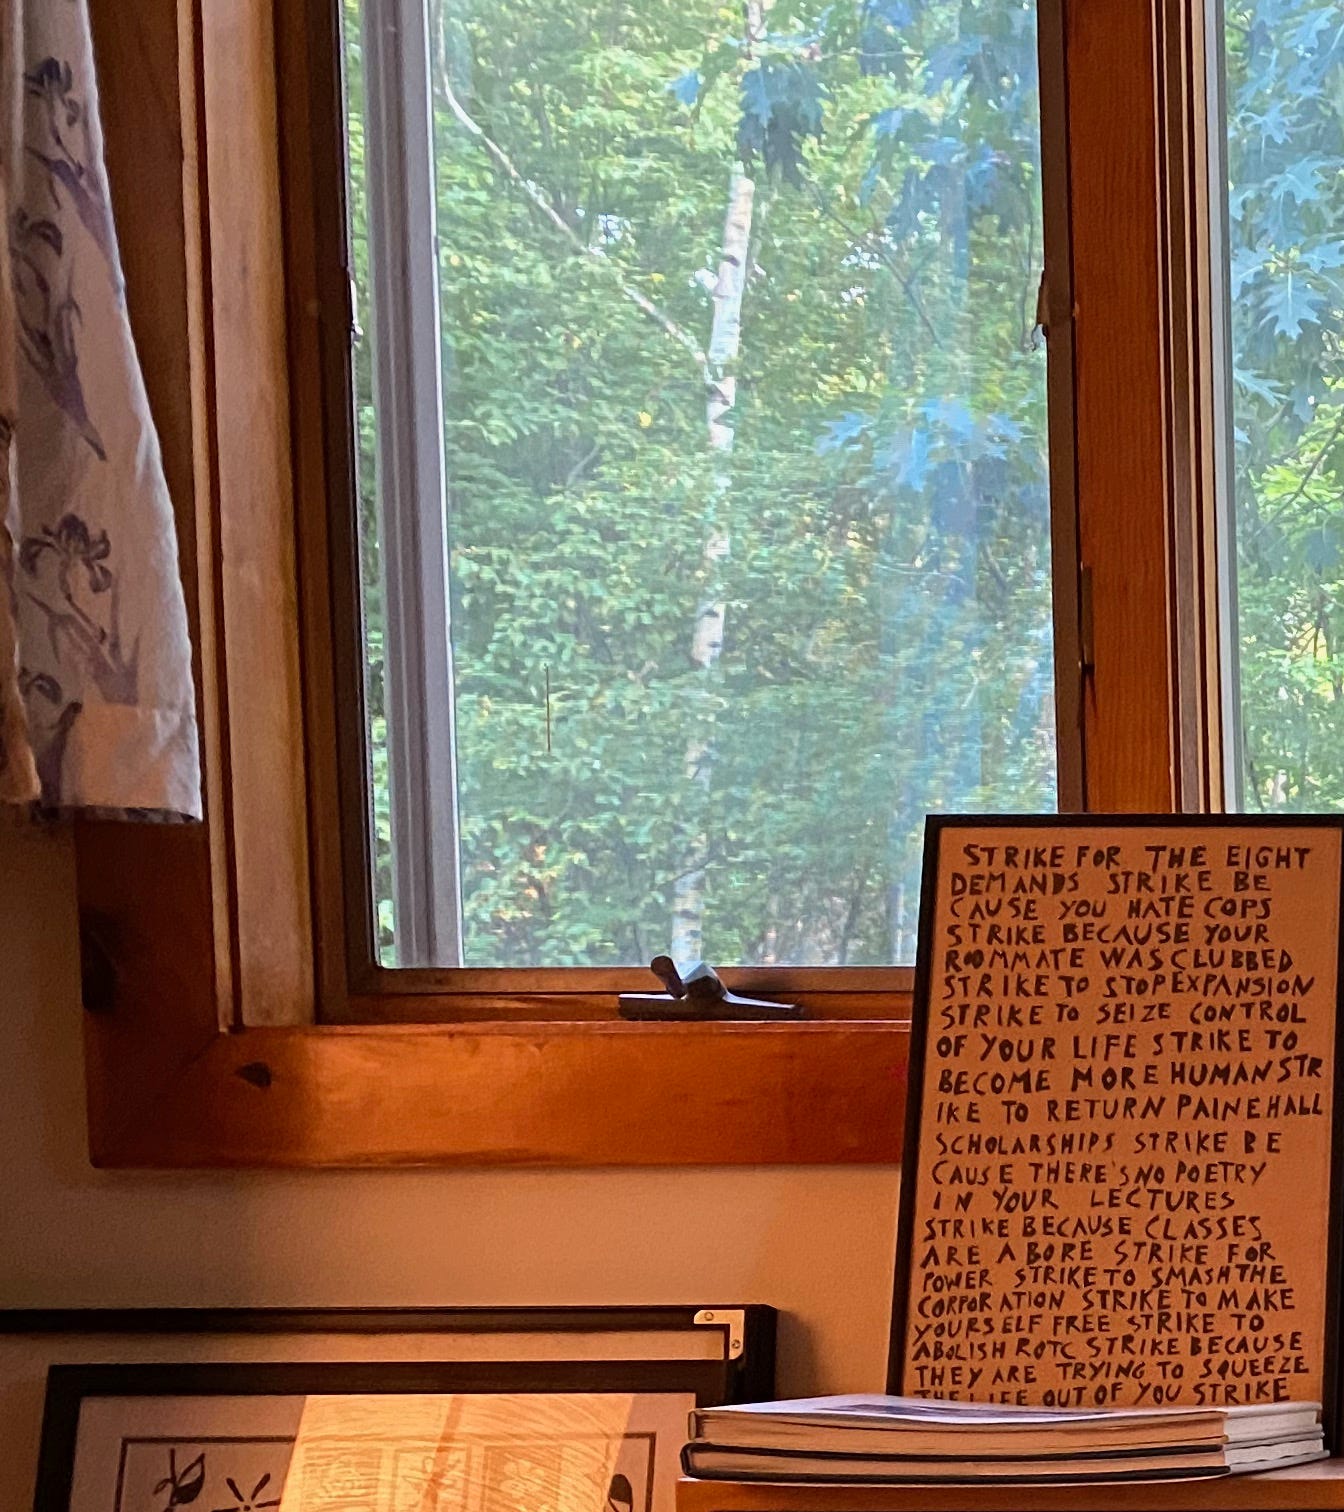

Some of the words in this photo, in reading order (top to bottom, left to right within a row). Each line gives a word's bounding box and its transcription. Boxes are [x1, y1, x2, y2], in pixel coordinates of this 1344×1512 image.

[964, 844, 1065, 869] STRIKE
[1076, 846, 1121, 869] FOR
[1145, 846, 1208, 869] THE
[1226, 846, 1311, 870] EIGHT
[950, 898, 1037, 920] CAUSE
[1060, 900, 1106, 919] YOU
[1128, 898, 1194, 918] HATE
[1204, 899, 1272, 919] COPS
[946, 924, 1045, 946] STRIKE
[1062, 924, 1190, 944] BECAUSE
[1204, 924, 1269, 944] YOUR
[940, 1004, 1043, 1030] STRIKE
[1056, 1004, 1079, 1024] TO
[1096, 1002, 1171, 1024] SEIZE
[1190, 1002, 1306, 1024] CONTROL
[936, 1036, 968, 1058] OF
[980, 1036, 1055, 1062] YOUR
[1073, 1034, 1138, 1060] LIFE
[1153, 1029, 1252, 1056] STRIKE
[1268, 1030, 1298, 1052] TO
[935, 1132, 1115, 1156] SCHOLARSHIPS
[1134, 1132, 1228, 1155] STRIKE
[1244, 1132, 1282, 1154] BE
